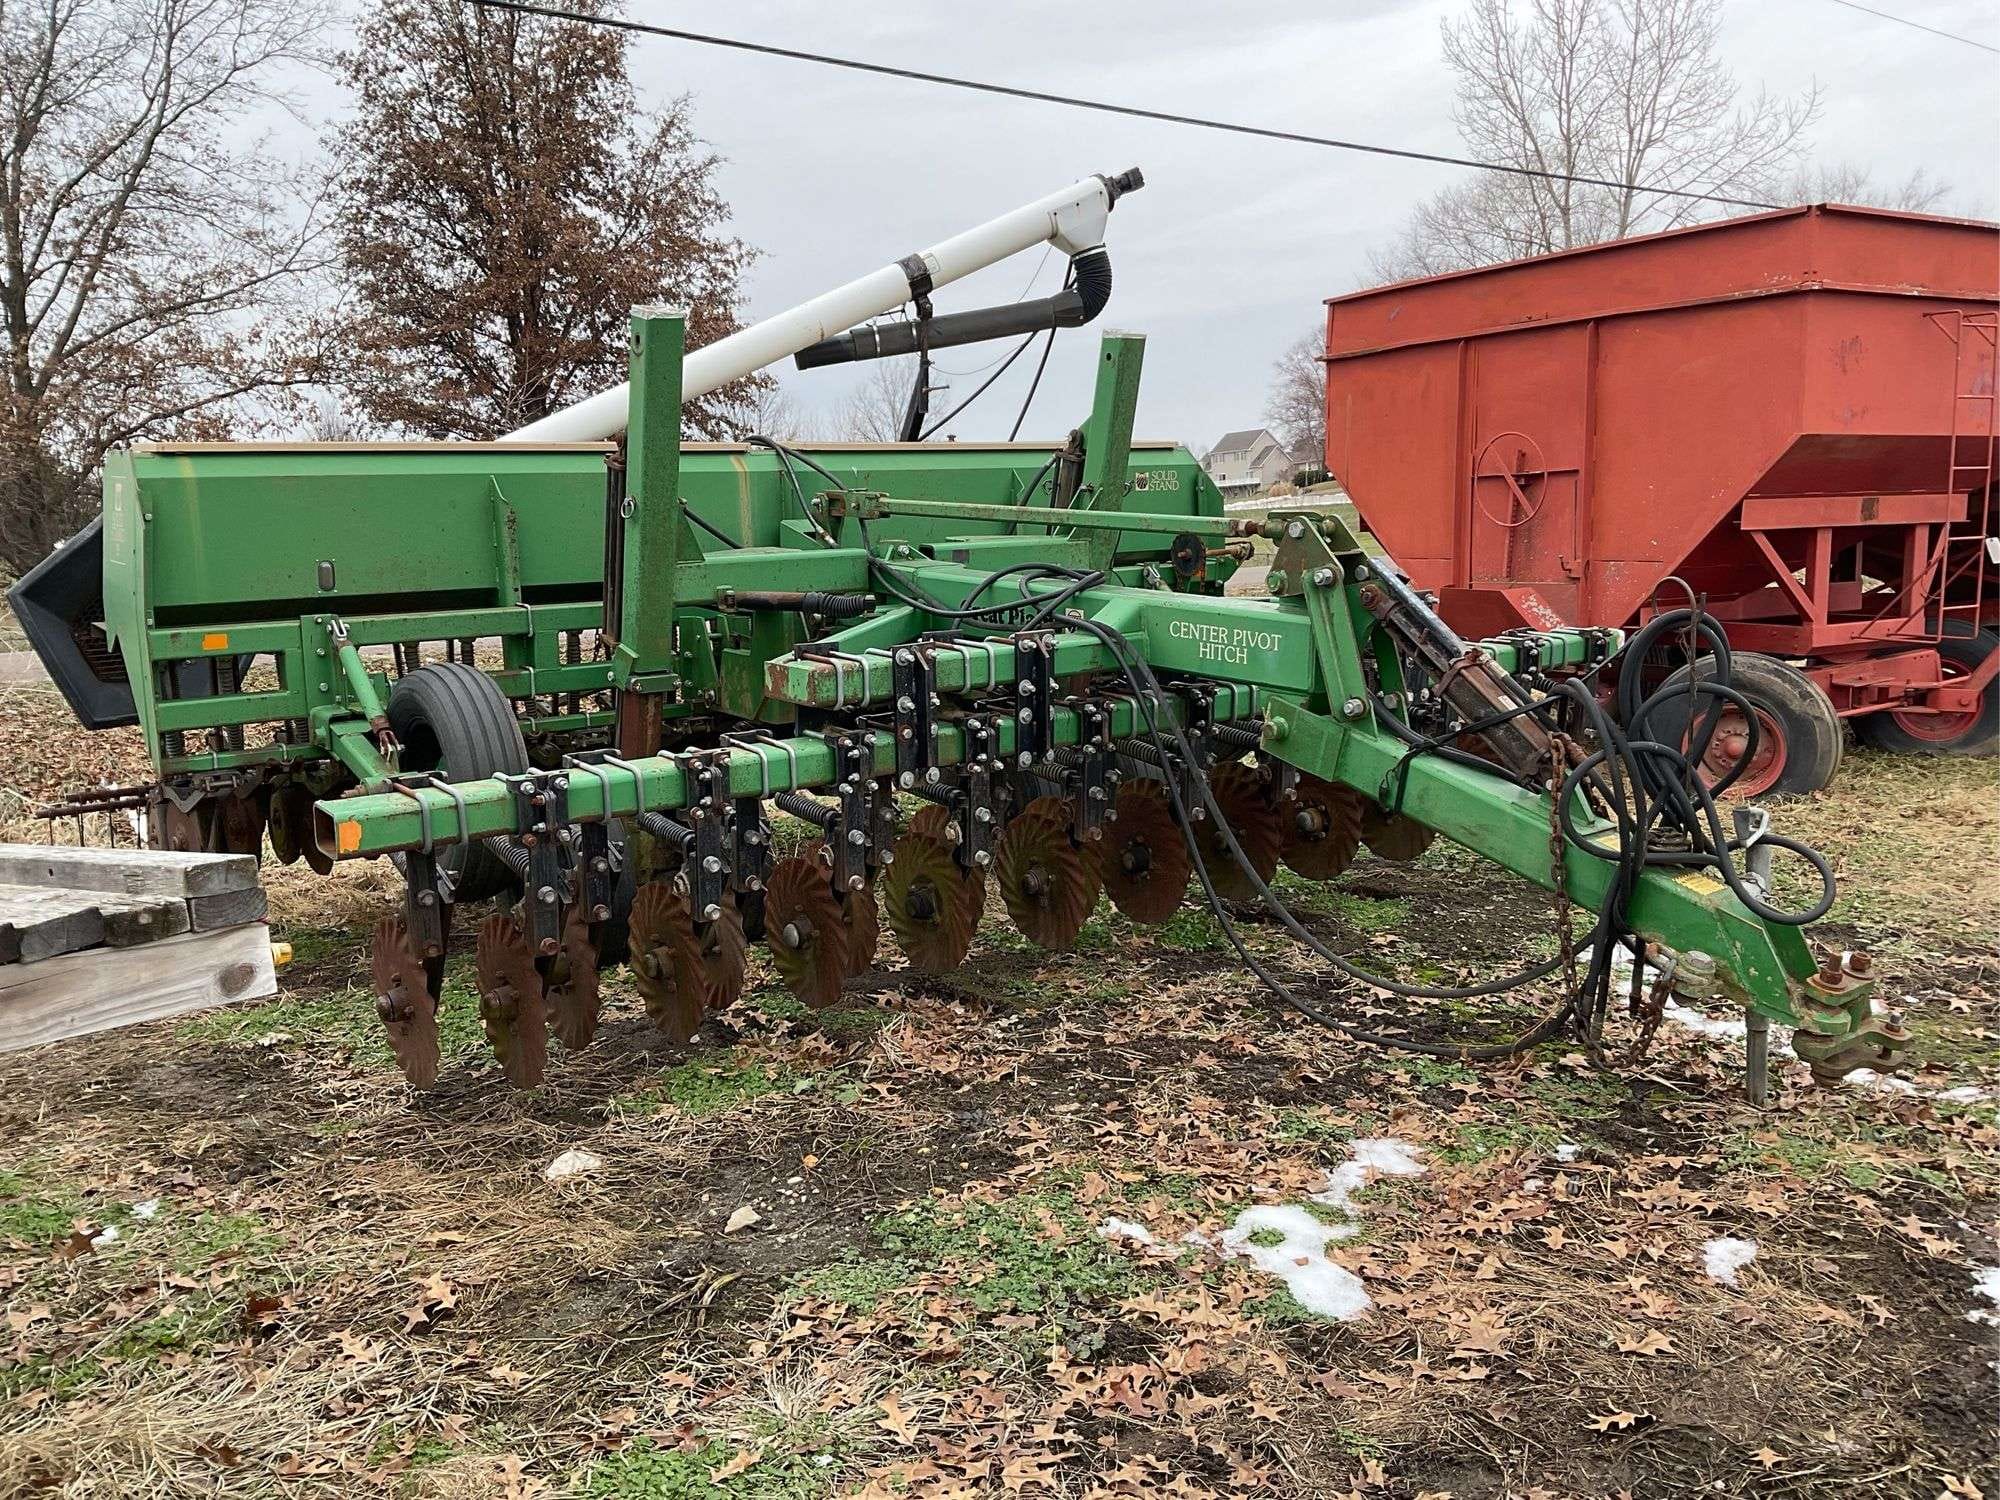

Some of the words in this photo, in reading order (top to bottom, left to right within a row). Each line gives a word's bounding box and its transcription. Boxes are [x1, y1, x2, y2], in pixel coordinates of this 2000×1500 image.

[1151, 470, 1178, 481] SOLID
[1149, 480, 1180, 492] STAND
[1169, 620, 1228, 645] CENTER
[1233, 628, 1283, 652] PIVOT
[1199, 641, 1248, 665] HITCH
